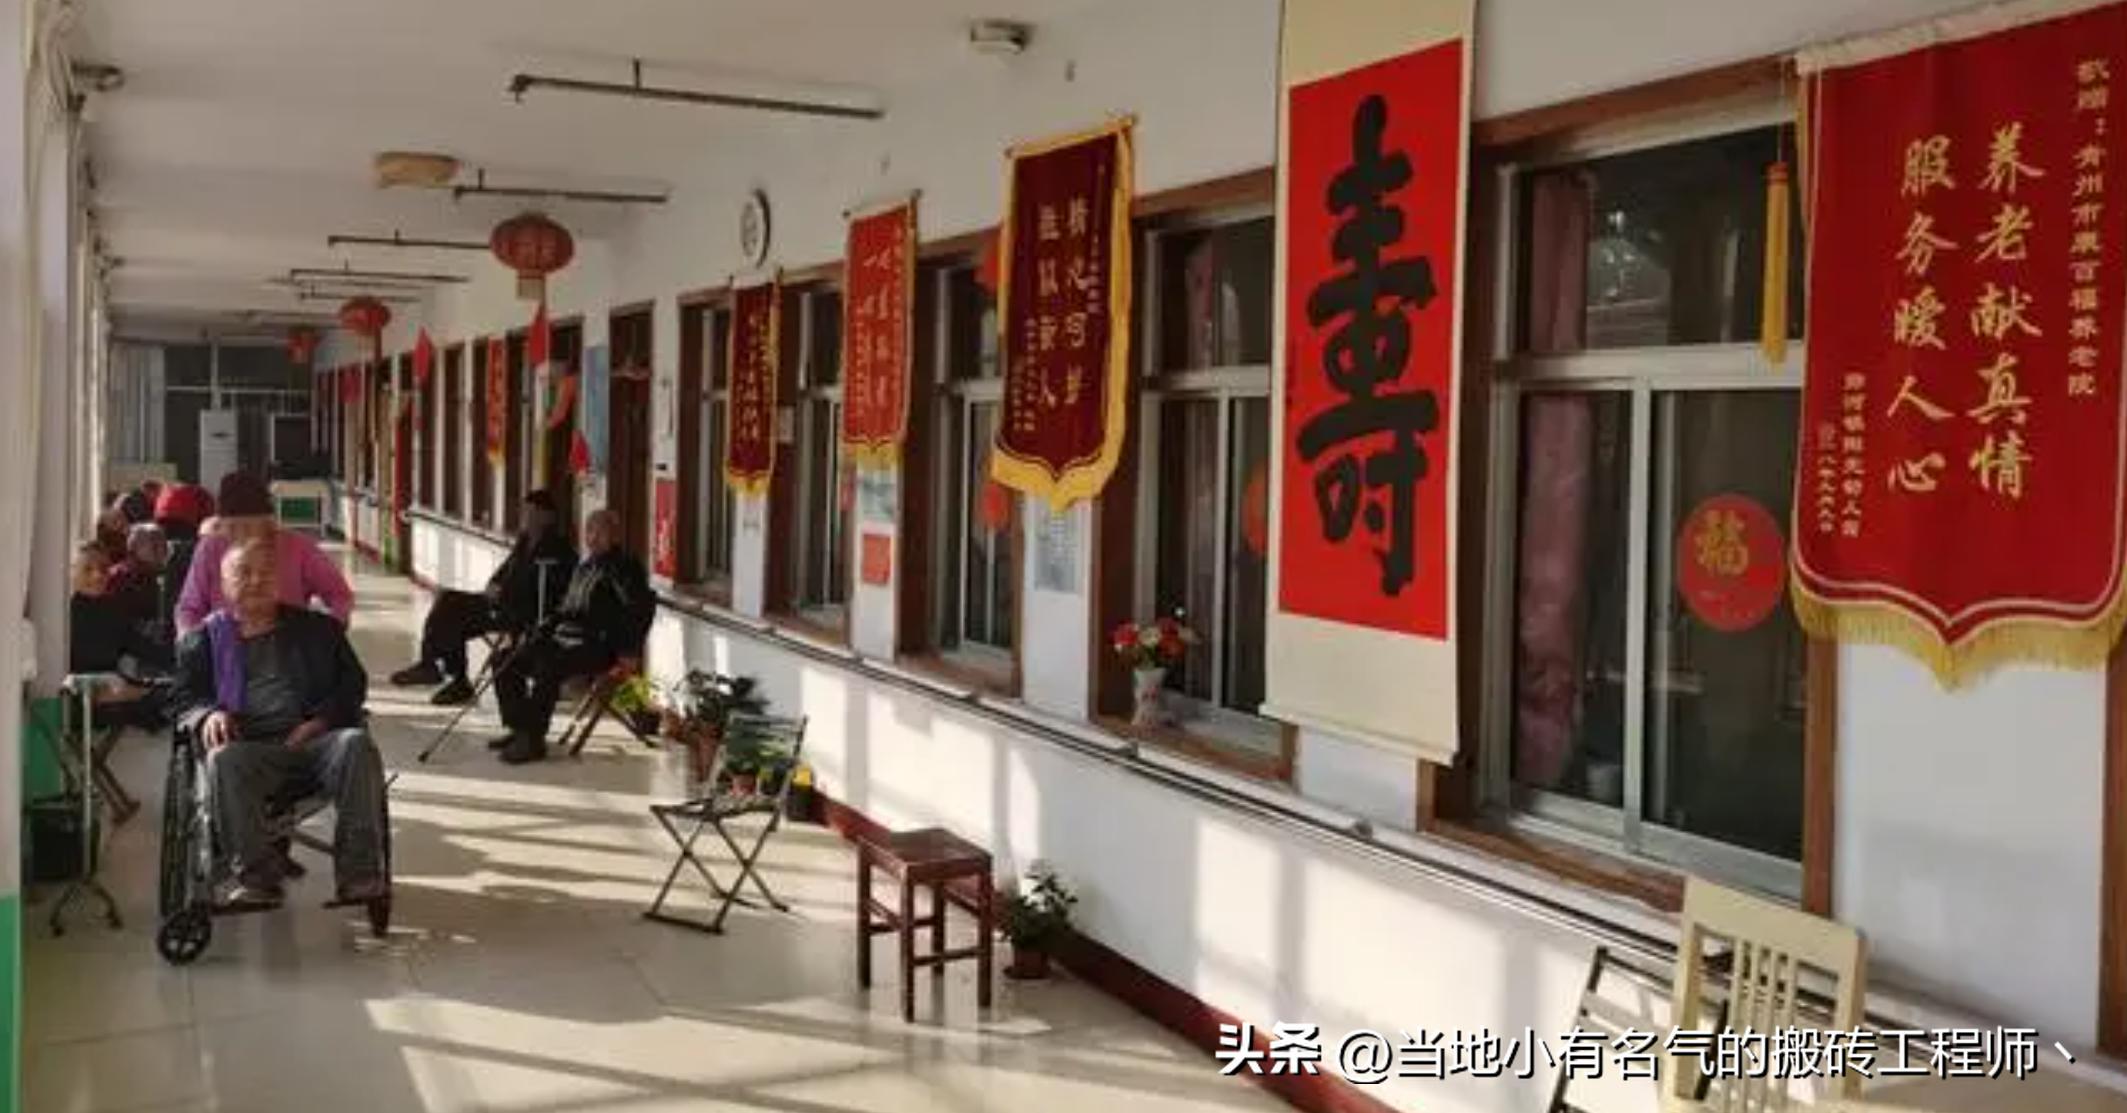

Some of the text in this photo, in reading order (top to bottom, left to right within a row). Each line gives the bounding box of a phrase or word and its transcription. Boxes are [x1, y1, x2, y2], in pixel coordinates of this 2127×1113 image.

[1887, 134, 1959, 492] 服务暖人心
[1965, 121, 2046, 499] 养老献真情
[1693, 508, 1750, 577] 福
